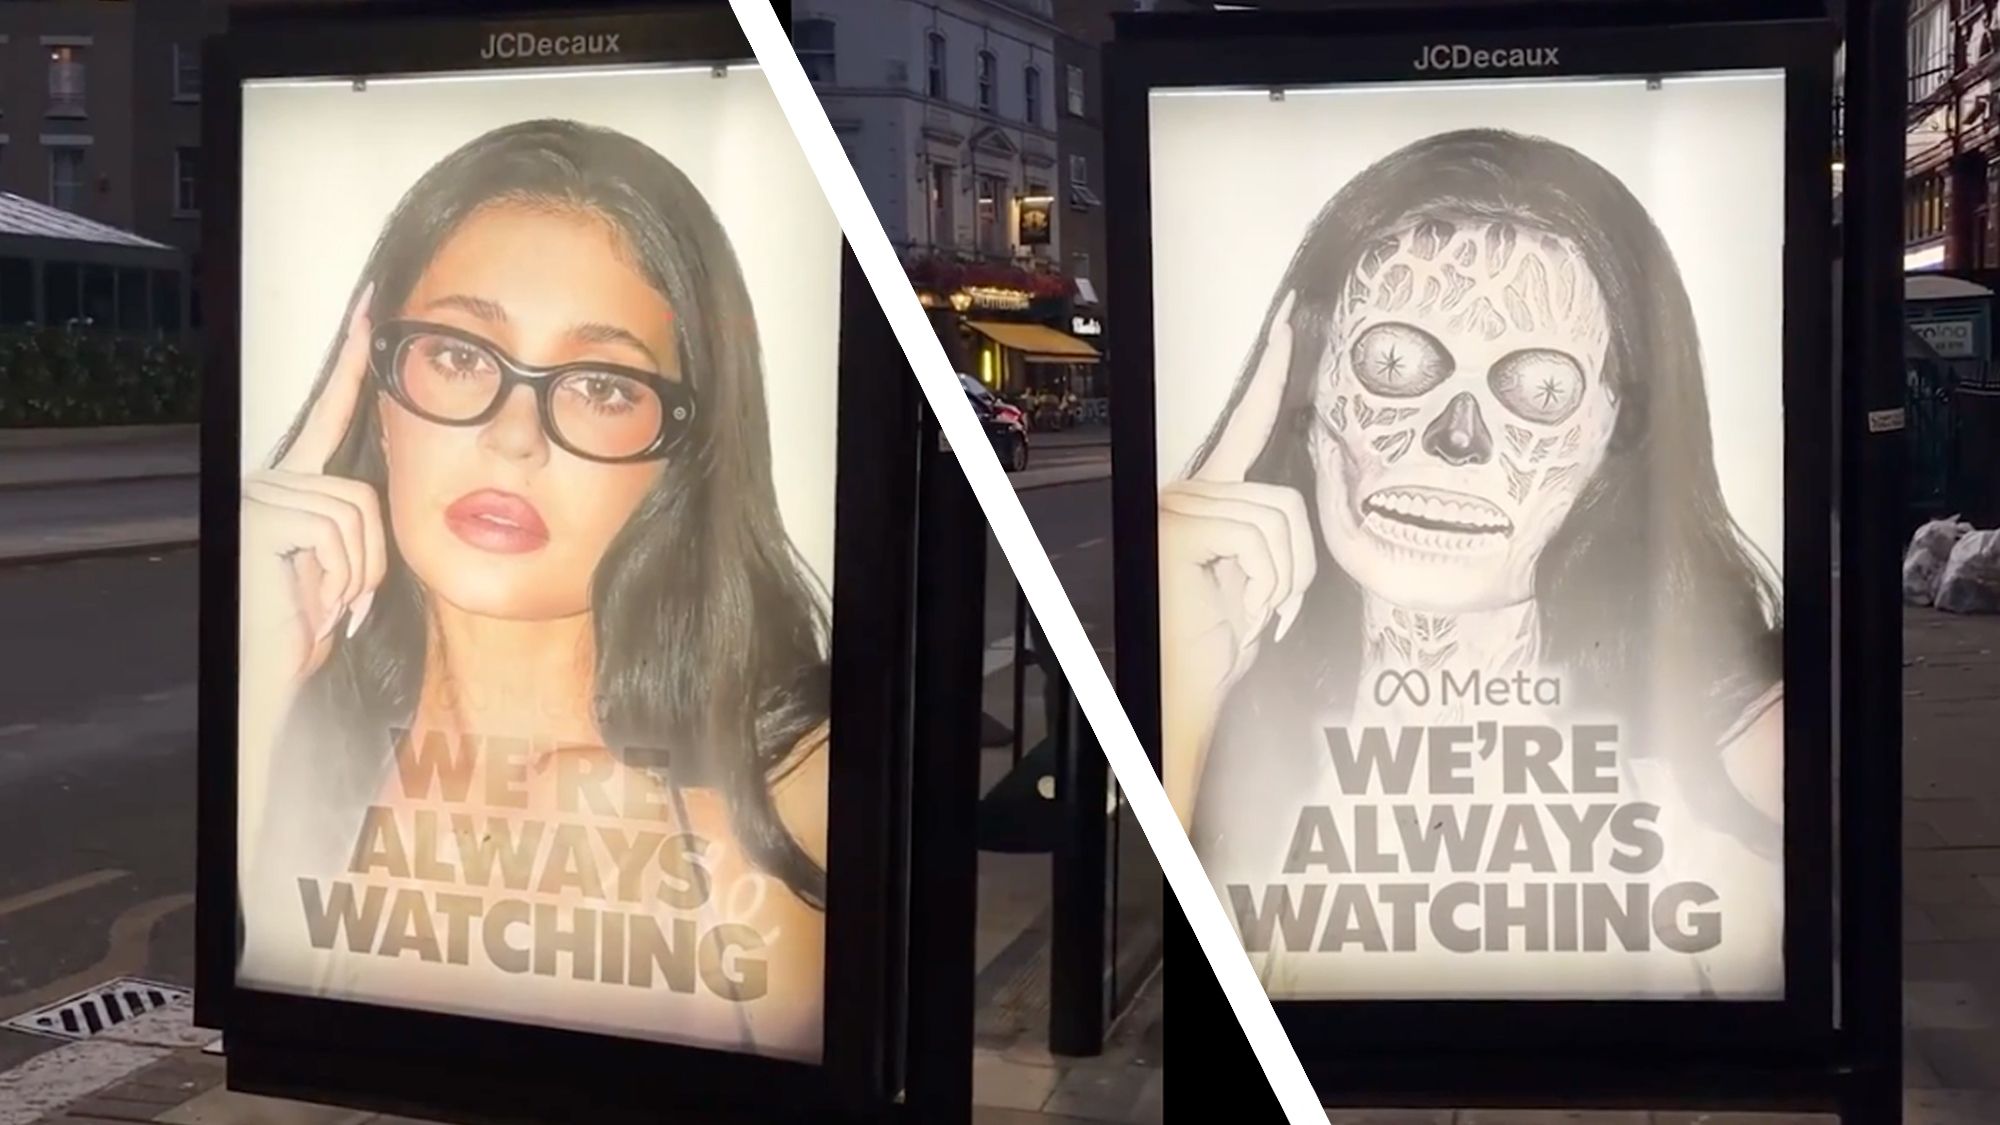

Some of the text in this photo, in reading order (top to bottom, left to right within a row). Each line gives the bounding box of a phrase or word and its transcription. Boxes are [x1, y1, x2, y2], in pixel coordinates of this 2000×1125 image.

[480, 32, 620, 59] JCDecaux
[1413, 44, 1559, 70] JCDecaux
[1441, 669, 1561, 706] Meta
[389, 727, 670, 823] WE’RE
[1323, 720, 1619, 795] WE’RE
[348, 804, 712, 911] ALWAYS
[1281, 801, 1664, 874] ALWAYS
[297, 876, 768, 1002] WATCHING
[1226, 881, 1722, 953] WATCHING
